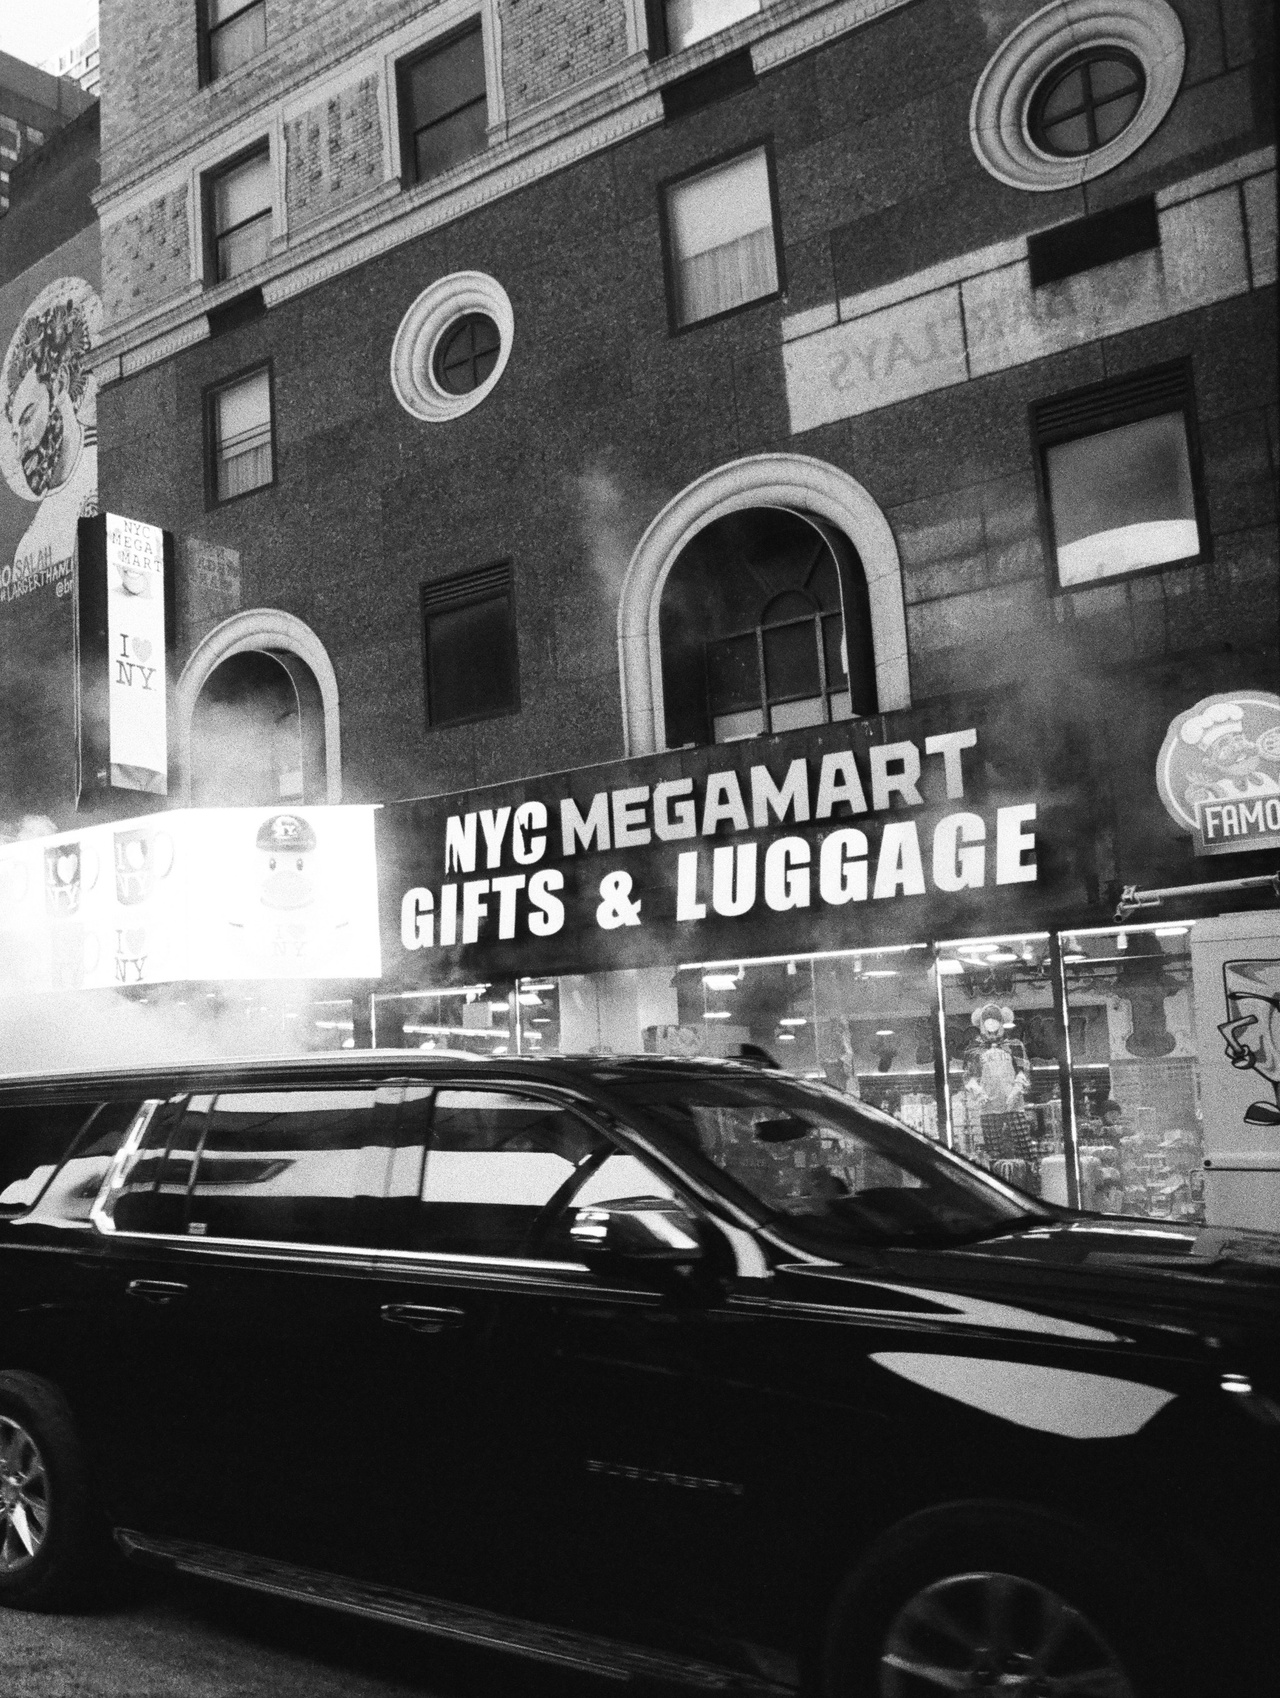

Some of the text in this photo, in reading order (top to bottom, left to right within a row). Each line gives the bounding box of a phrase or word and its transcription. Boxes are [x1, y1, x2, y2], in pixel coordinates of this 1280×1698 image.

[123, 520, 151, 539] NYC
[111, 532, 153, 555] MEGA
[120, 550, 163, 573] MART
[120, 633, 130, 658] I
[115, 660, 157, 690] NY
[444, 728, 978, 875] NYC MEGAMART
[1205, 798, 1280, 839] FAMO
[400, 803, 1038, 951] GIFTS & LUGGAGE
[114, 955, 148, 982] NY
